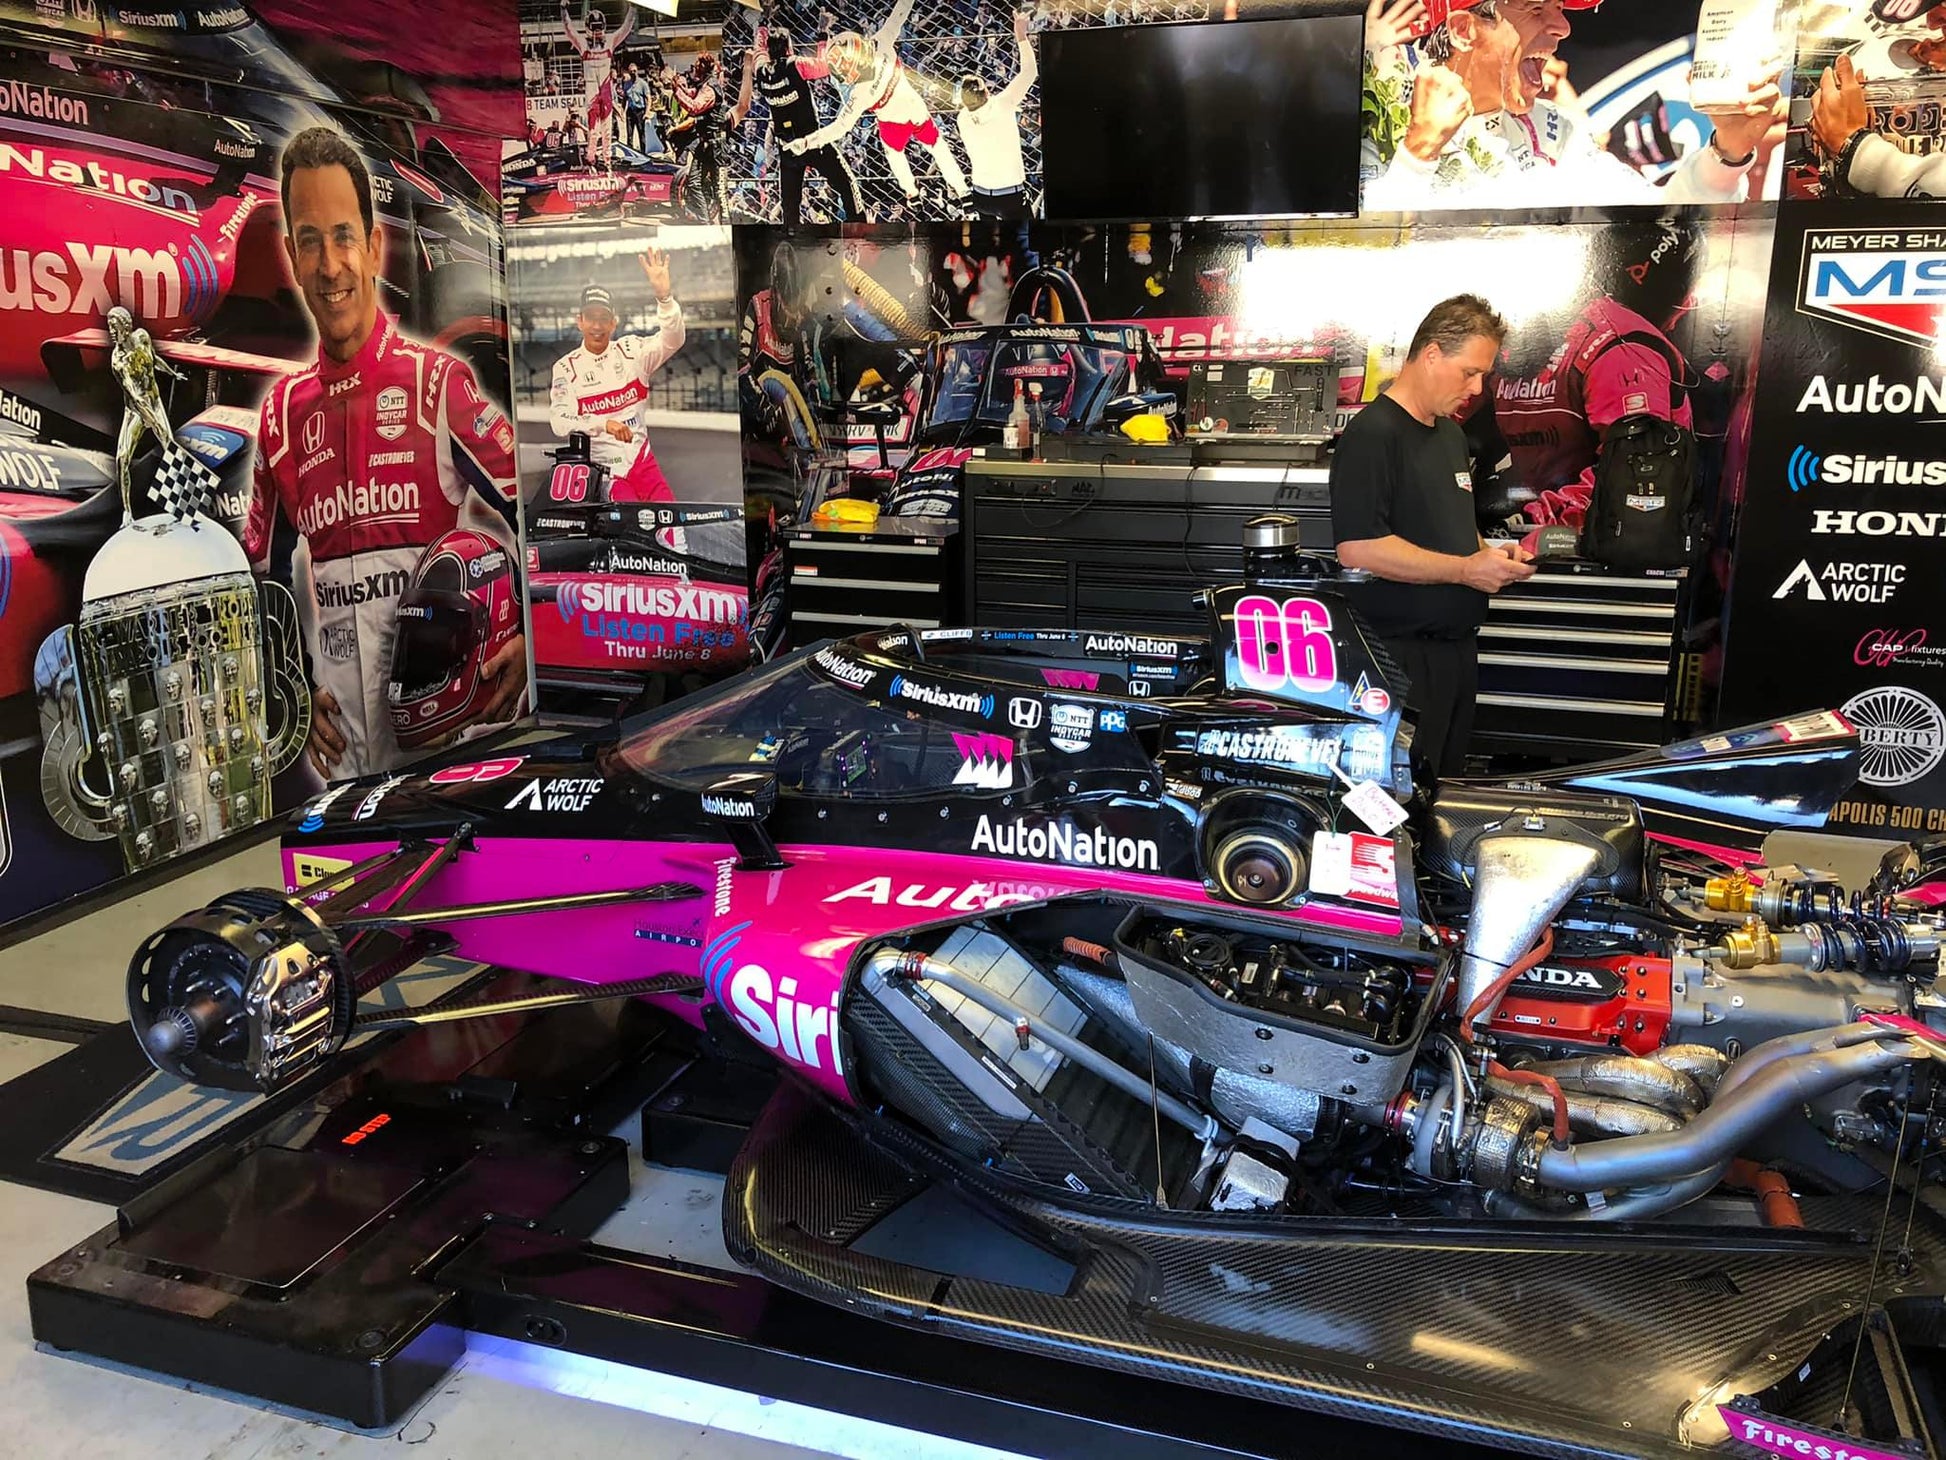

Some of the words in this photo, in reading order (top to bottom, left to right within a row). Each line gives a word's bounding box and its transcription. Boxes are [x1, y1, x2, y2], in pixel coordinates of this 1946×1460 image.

[535, 98, 560, 111] TEAM
[214, 138, 256, 159] AutoNation
[1811, 235, 1900, 250] MEYER
[1294, 364, 1335, 377] FAST
[581, 386, 638, 414] AutoNation
[1795, 374, 1946, 414] AutoN
[298, 447, 336, 478] HONDA
[550, 463, 590, 503] 06
[296, 476, 421, 538] AutoNation
[1810, 510, 1946, 537] HON
[611, 554, 688, 575] AutoNation
[1821, 562, 1907, 583] ARCTIC
[1831, 583, 1896, 604] WOLF
[582, 615, 665, 642] Listen
[675, 623, 736, 646] Free
[994, 632, 1017, 640] Listen
[1017, 632, 1035, 640] Free
[605, 641, 646, 659] Thru
[652, 645, 696, 661] June
[1085, 635, 1178, 655] AutoNation
[1234, 594, 1338, 692] 06
[1872, 643, 1904, 652] CAP
[1070, 714, 1089, 725] NTT
[1101, 711, 1126, 731] PPG
[1050, 724, 1092, 739] INDYCAR
[543, 778, 605, 794] ARCTIC
[547, 795, 593, 812] WOLF
[1890, 805, 1923, 829] 500
[971, 814, 1161, 871] AutoNation
[713, 856, 737, 918] Firestone
[342, 1131, 367, 1145] NO
[359, 1113, 392, 1133] STEP
